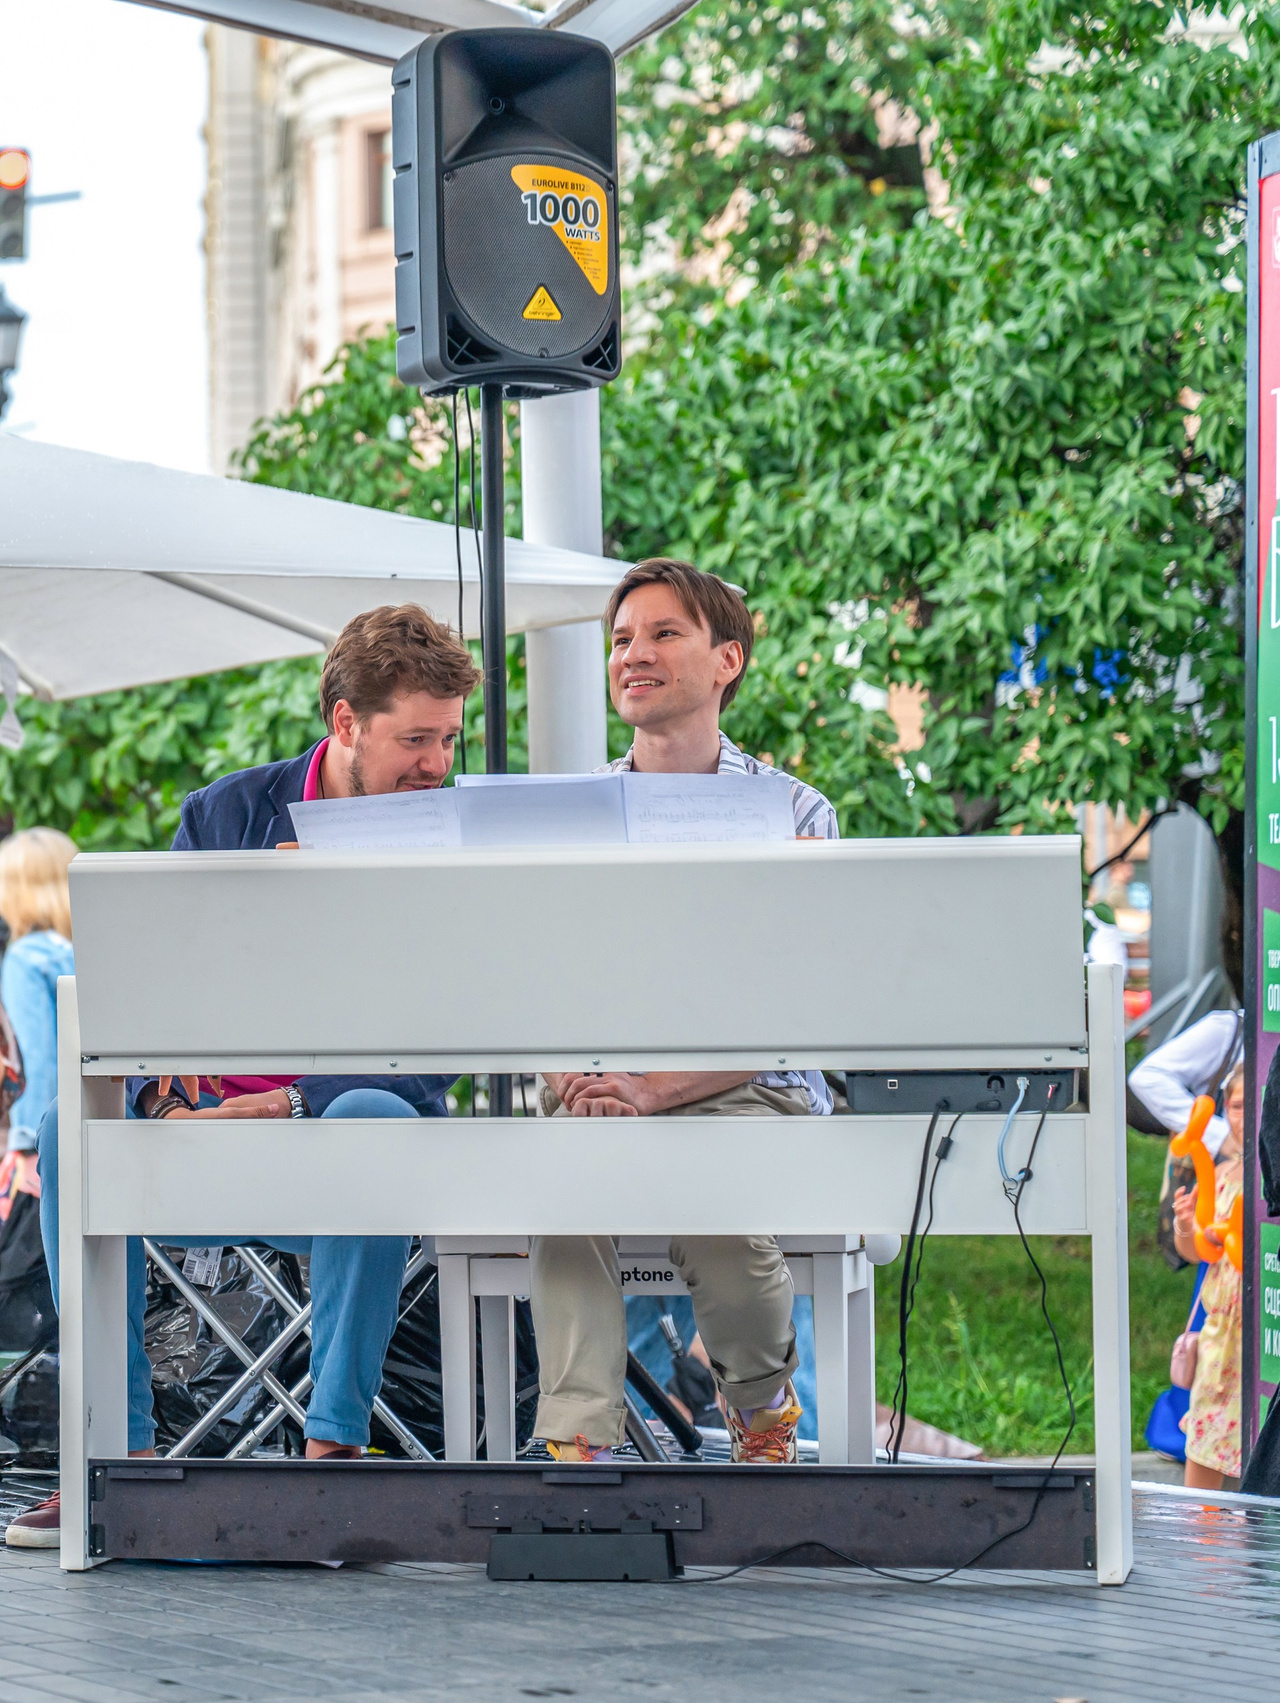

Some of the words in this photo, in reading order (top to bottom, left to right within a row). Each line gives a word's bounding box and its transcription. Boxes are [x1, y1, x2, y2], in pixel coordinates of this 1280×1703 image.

[531, 178, 569, 190] EUROLIVE
[522, 191, 600, 229] 1000
[565, 227, 600, 241] WATTS
[1269, 716, 1280, 784] 1
[1269, 813, 1280, 844] ТЕ
[621, 1266, 674, 1287] ptone
